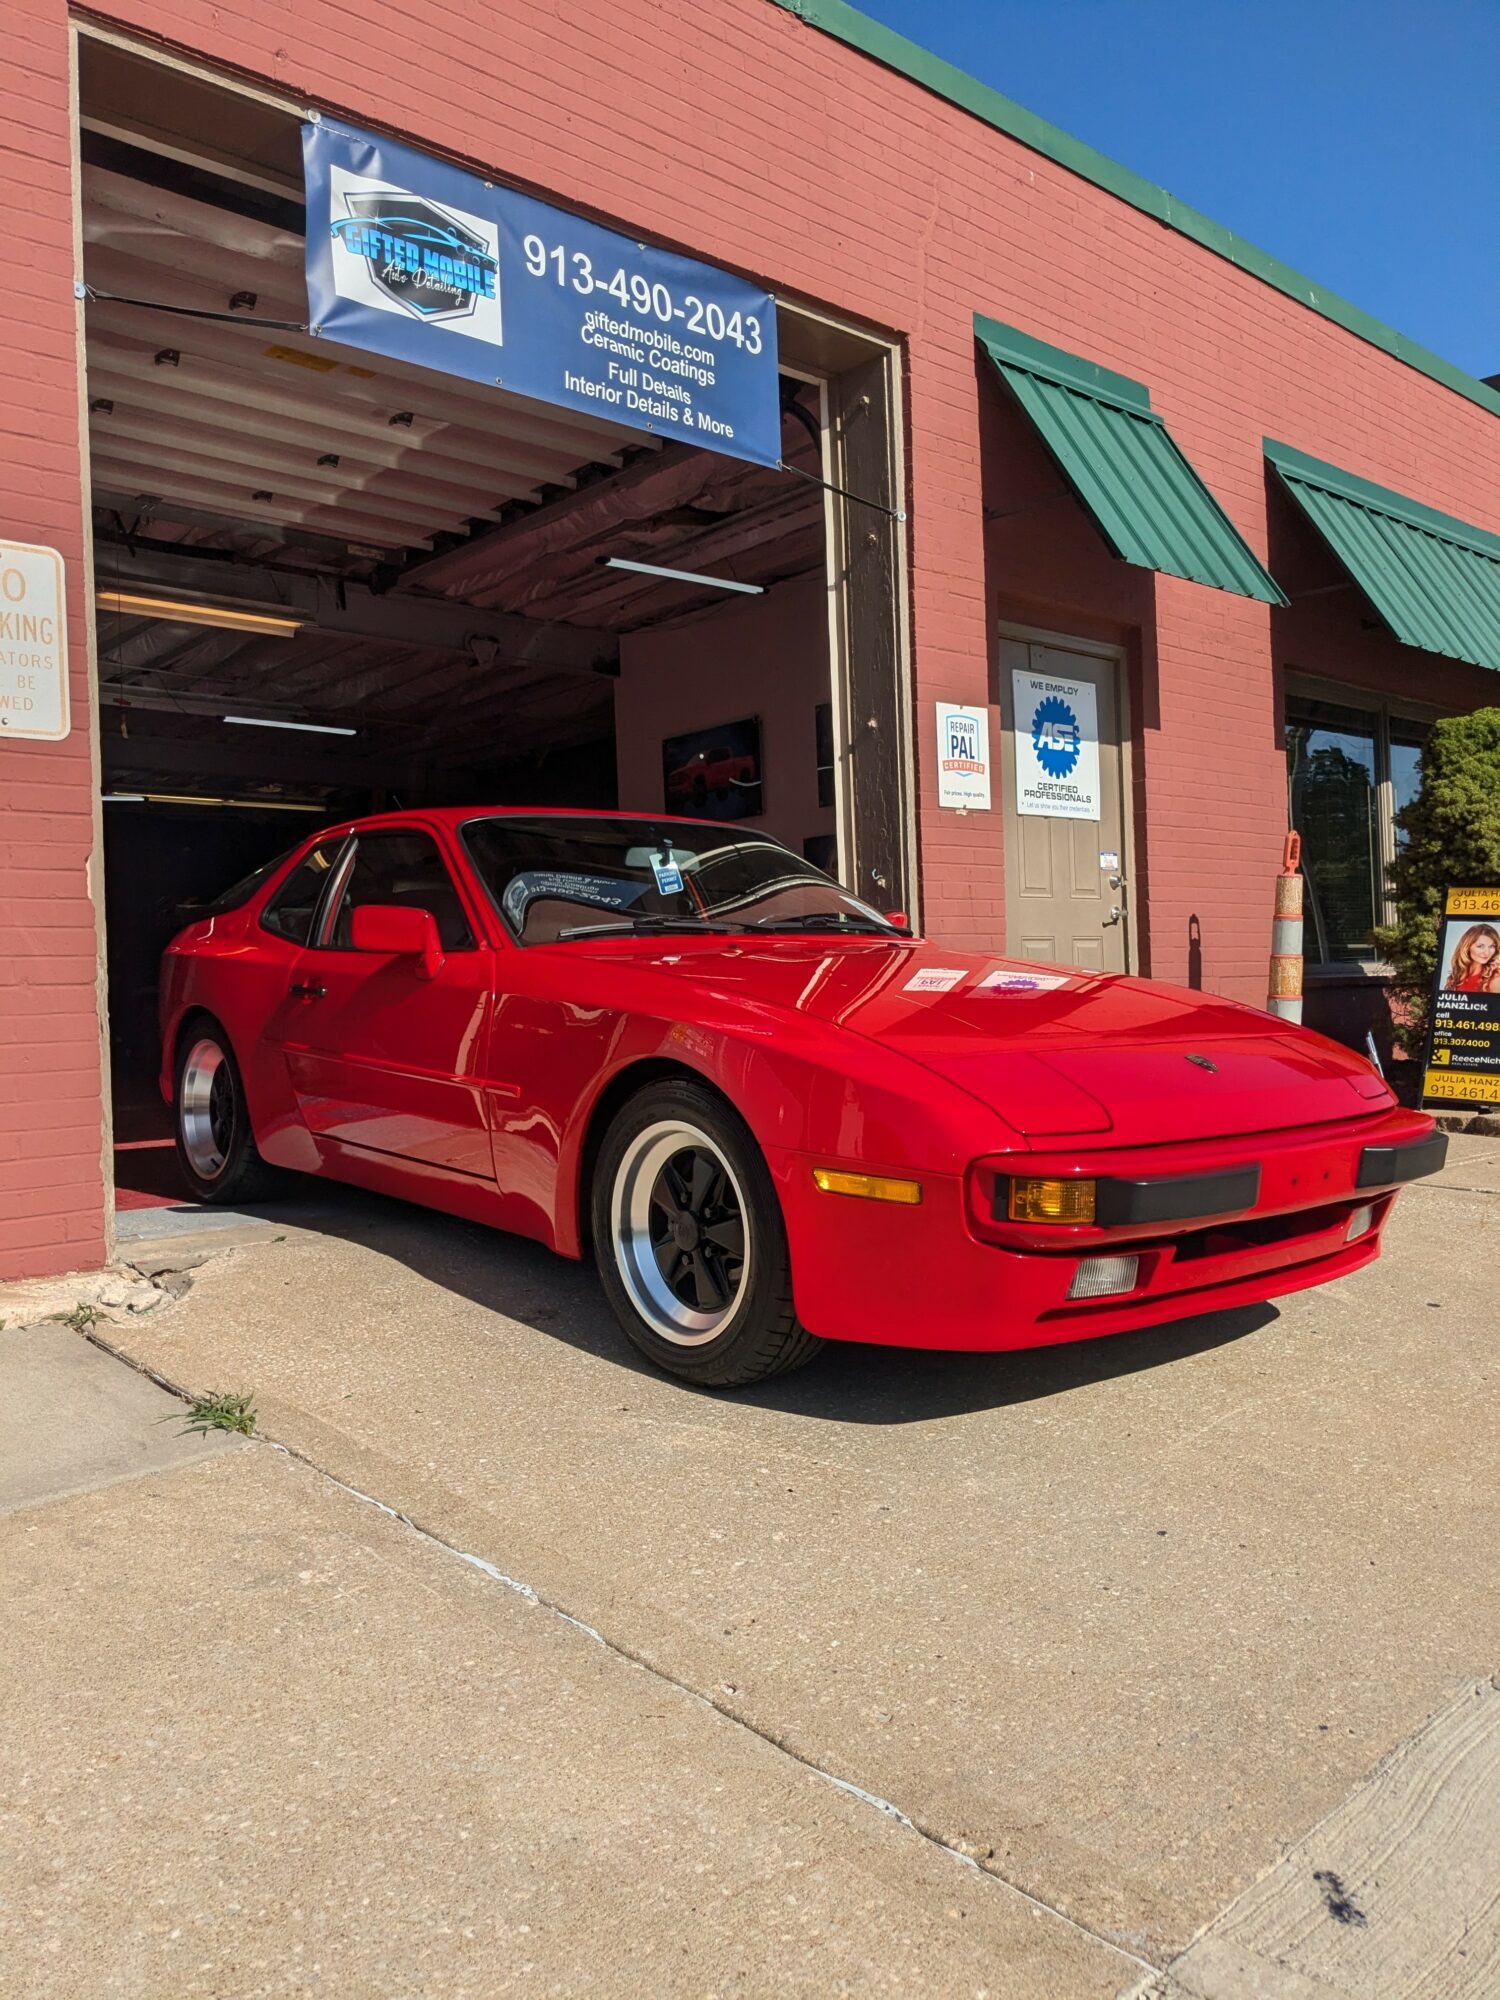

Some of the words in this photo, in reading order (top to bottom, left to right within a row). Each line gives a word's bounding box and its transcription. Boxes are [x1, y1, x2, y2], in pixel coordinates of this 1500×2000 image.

[344, 224, 419, 274] GIFTED
[423, 248, 497, 300] MOBILE
[381, 259, 408, 284] Auto
[412, 266, 465, 306] Detailing
[523, 234, 763, 355] 913-490-2043
[585, 311, 715, 367] giftedmobile.com
[581, 324, 645, 363] Ceramic
[649, 349, 716, 387] Coatings
[608, 362, 637, 387] Full
[642, 372, 692, 405] Details
[565, 370, 622, 404] Interior
[626, 390, 679, 421] Details
[682, 407, 694, 426] &
[698, 412, 734, 438] More
[17, 674, 36, 690] BE
[1030, 680, 1043, 690] WE
[1045, 683, 1079, 695] EMPLOY
[950, 721, 975, 734] REPAIR
[1038, 721, 1074, 752] ASE
[951, 734, 975, 760] PAL
[944, 760, 984, 773] CERTIFIED
[1037, 782, 1078, 794] CERTIFIED
[1024, 789, 1092, 803] PROFESSIONALS
[1457, 889, 1487, 897] JULIA
[1453, 899, 1500, 910] 913.46
[1438, 993, 1468, 1001] JULIA
[1436, 1001, 1488, 1011] HANZLICK
[1435, 1019, 1500, 1031] 913.461.498
[1435, 1075, 1466, 1084] JULIA
[1469, 1077, 1500, 1087] HANZ
